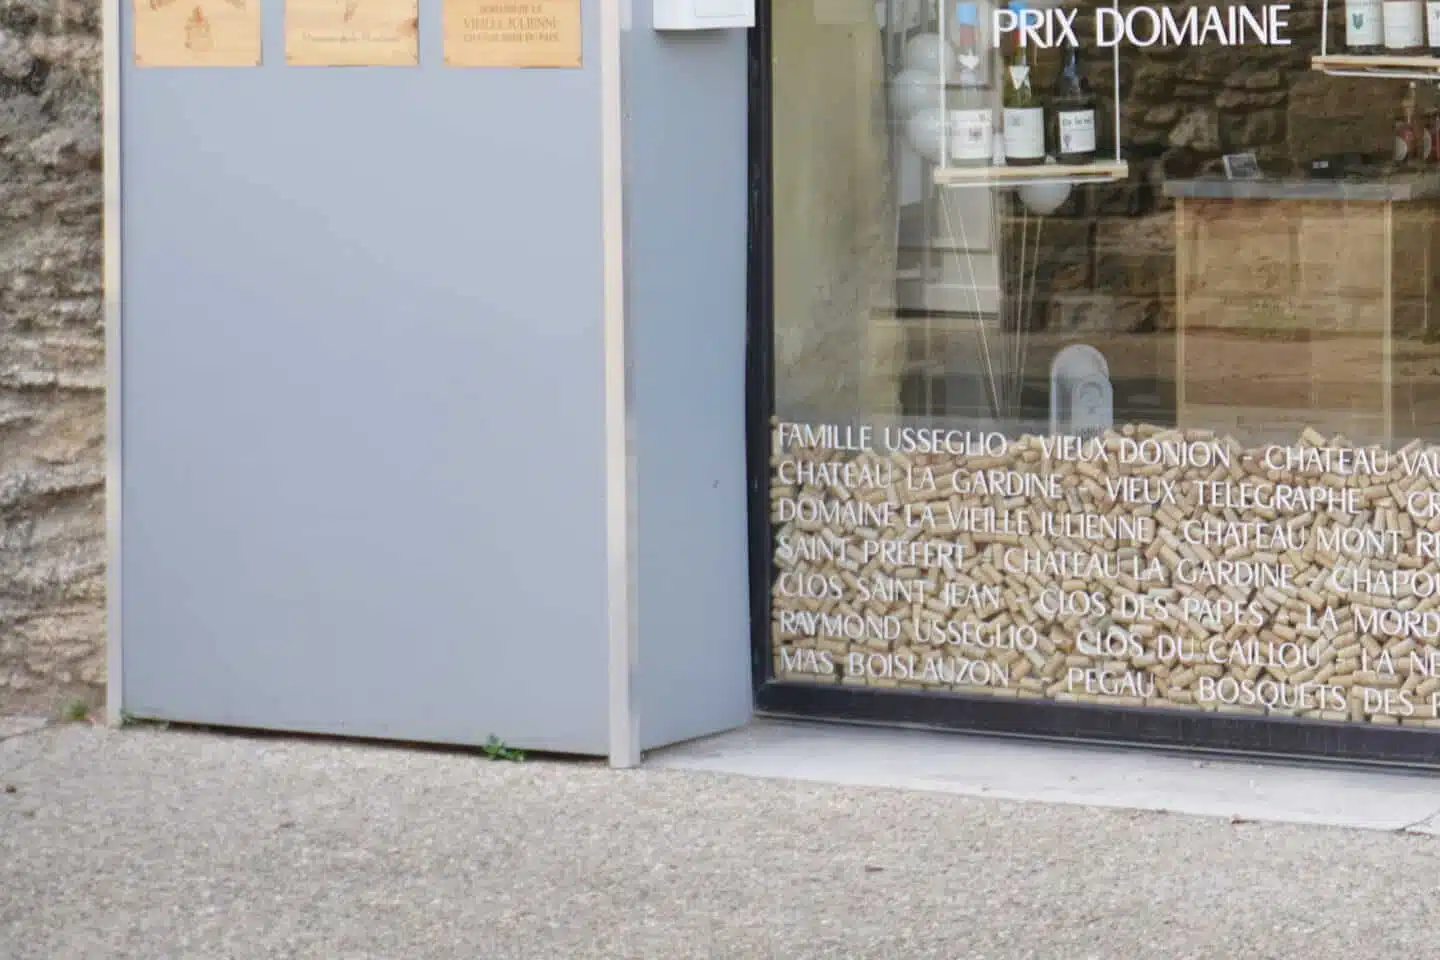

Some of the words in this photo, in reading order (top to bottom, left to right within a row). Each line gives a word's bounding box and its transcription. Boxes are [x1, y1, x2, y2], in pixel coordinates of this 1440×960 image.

[991, 7, 1080, 50] PRIX
[1097, 4, 1292, 48] DOMAINE
[778, 423, 873, 451] FAMILLE
[884, 427, 1008, 458] USSEGLIO
[1037, 434, 1109, 462] VIEUX
[1265, 445, 1389, 477] CHATEAU
[778, 460, 892, 490] CHATEAU
[907, 466, 936, 491] LA
[951, 468, 1063, 499] GARDINE
[1105, 476, 1177, 505] VIEUX
[1197, 480, 1362, 515] TELEGRAPHE
[778, 497, 894, 527] DOMAINE
[906, 503, 936, 529] LA
[949, 505, 1030, 535] VIEILLE
[1038, 510, 1149, 541] JULIENNE
[1183, 519, 1305, 553] CHATEAU
[1316, 527, 1400, 556] MONT
[778, 536, 849, 561] SAINT
[1003, 548, 1120, 579] CHATEAU
[1132, 555, 1164, 581] LA
[1176, 558, 1293, 589] GARDINE
[778, 573, 843, 599] CLOS
[858, 577, 925, 603] SAINT
[940, 583, 1000, 609] JEAN
[1039, 590, 1106, 618] CLOS
[1120, 594, 1169, 620] DES
[1181, 598, 1264, 628] PAPES
[1305, 605, 1338, 632] LA
[778, 609, 901, 641] RAYMOND
[913, 620, 1038, 651] USSEGLIO
[1075, 631, 1144, 657] CLOS
[1157, 634, 1195, 662] DU
[1207, 638, 1321, 670] CAILLOU
[1361, 649, 1397, 676] LA
[779, 647, 834, 674] MAS
[849, 652, 1010, 686] BOISLAUZON
[1067, 667, 1155, 697] PEGAU
[1198, 675, 1346, 711] BOSQUETS
[1364, 687, 1415, 716] DES
